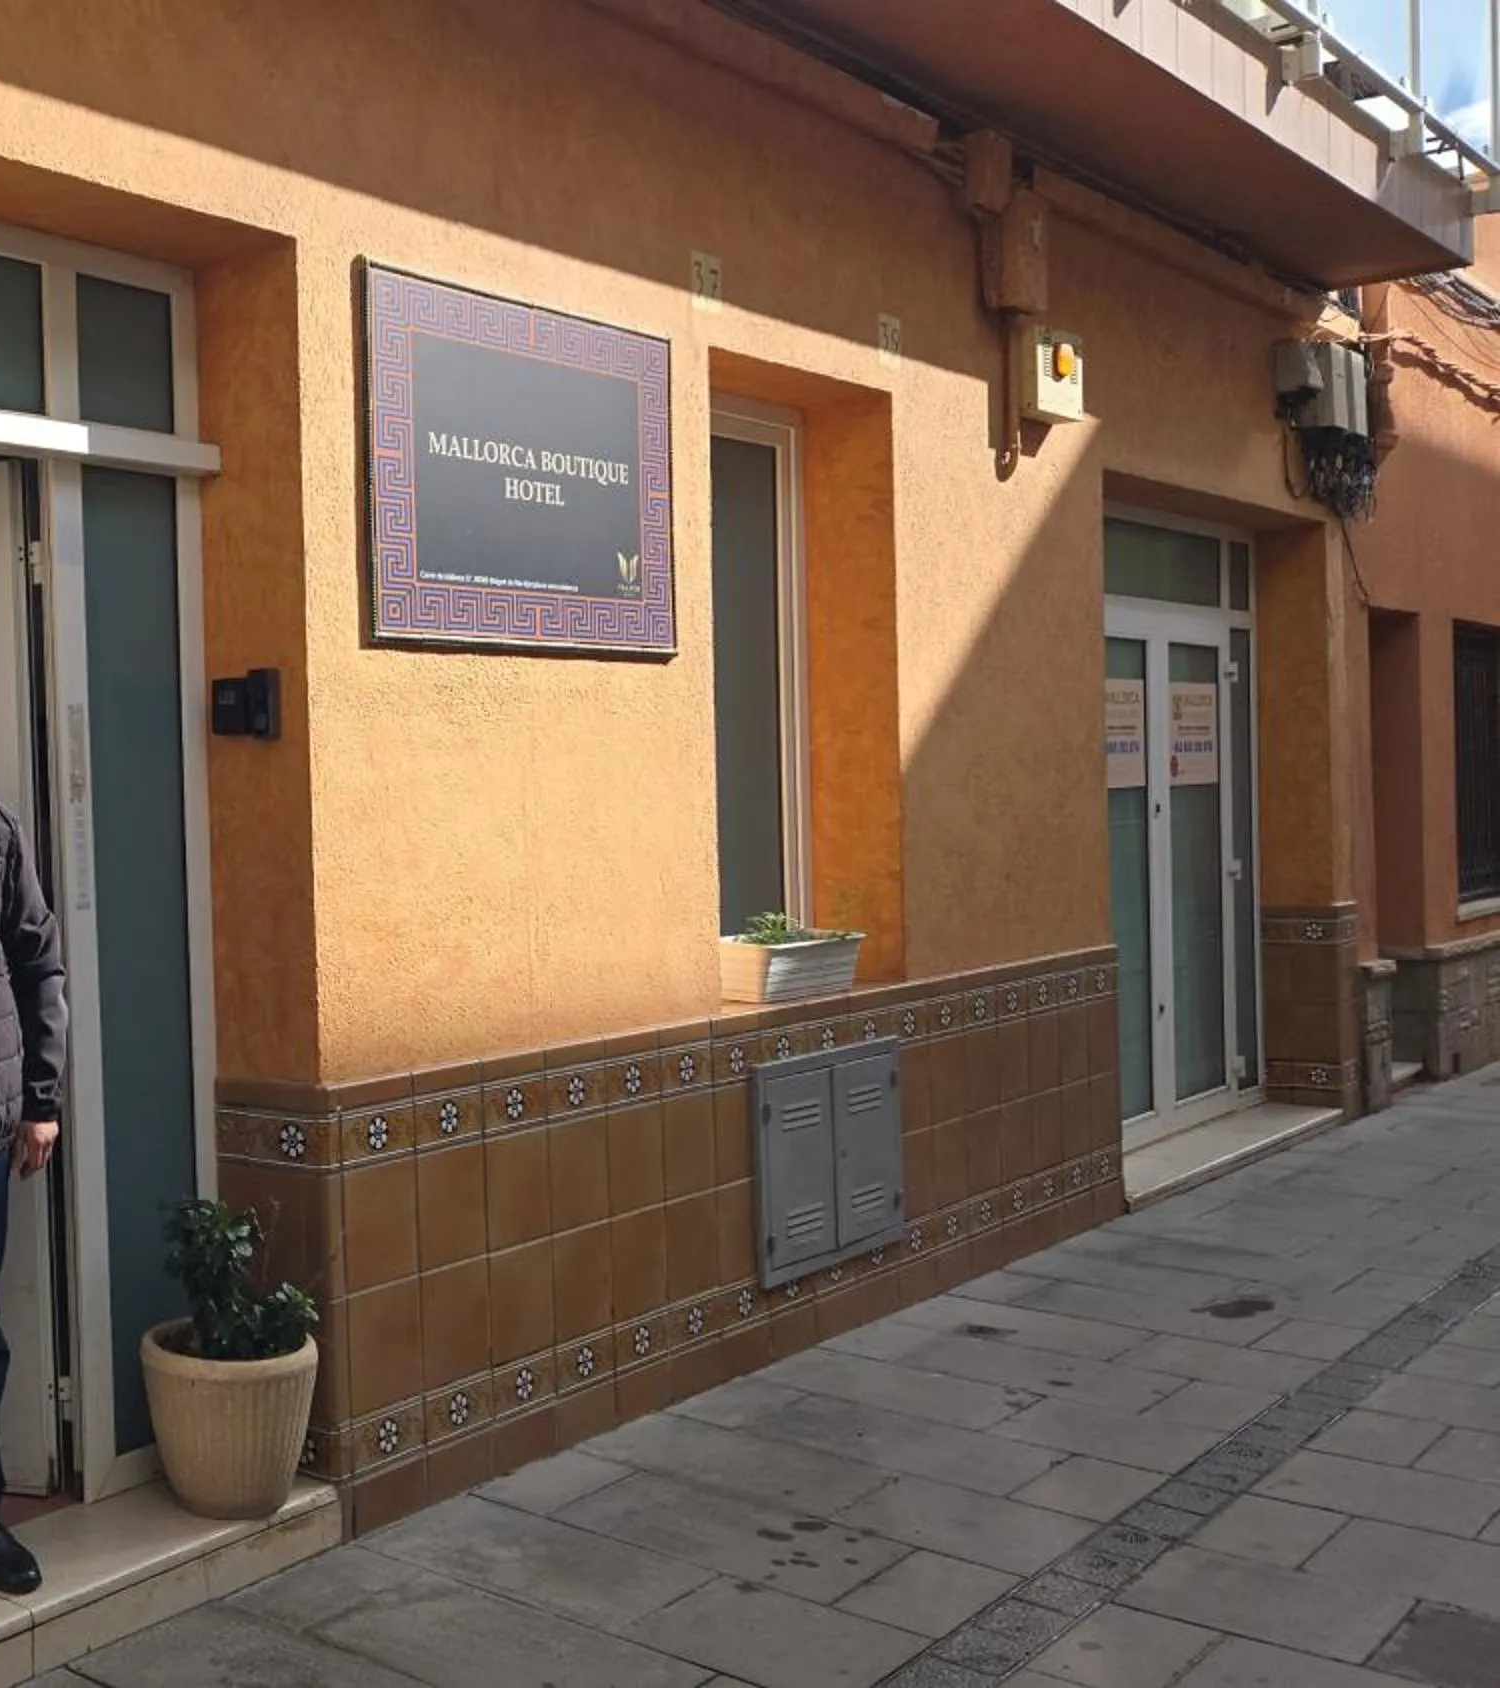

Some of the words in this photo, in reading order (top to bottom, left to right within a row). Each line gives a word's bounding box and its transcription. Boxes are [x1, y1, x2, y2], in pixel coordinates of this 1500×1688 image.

[428, 431, 537, 470] MALLORCA
[541, 451, 629, 485] BOUTIQUE
[504, 477, 565, 505] HOTEL
